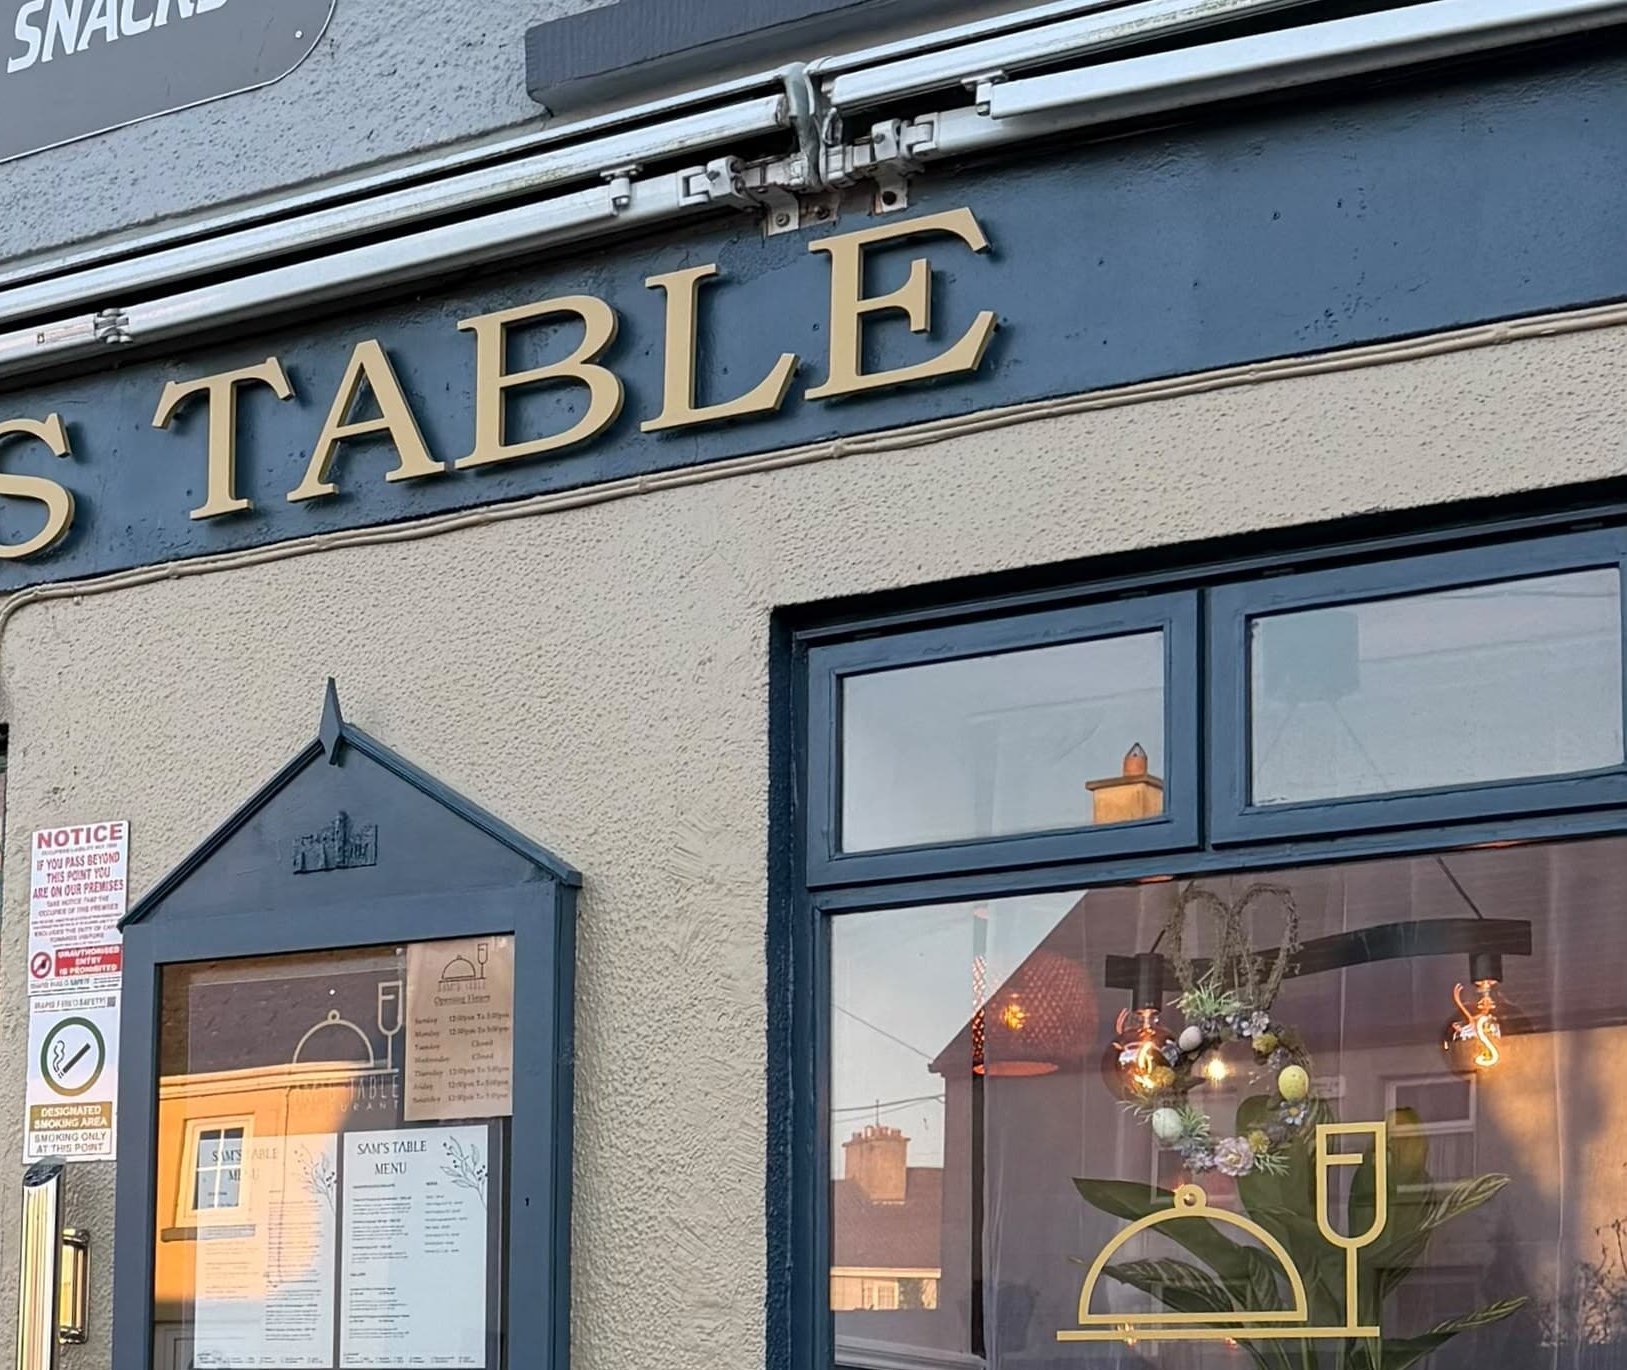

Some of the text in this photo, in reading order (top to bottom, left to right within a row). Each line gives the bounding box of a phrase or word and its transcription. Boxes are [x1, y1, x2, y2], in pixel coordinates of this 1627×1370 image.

[152, 206, 999, 520] TABLE
[37, 823, 123, 849] NOTICE
[37, 851, 120, 871] IF YOU PASS BEYOND
[47, 866, 111, 883] THIS POINT YOU
[33, 879, 124, 899] ARE ON OUR PREMISES
[57, 946, 120, 959] UNAUTHORISED
[75, 956, 102, 966] ENTRY
[59, 964, 118, 976] IS PROHIBITED
[350, 1075, 400, 1100] TABLE
[41, 1105, 101, 1118] DESIGNATED
[34, 1117, 108, 1129] SMOKING AREA
[34, 1131, 107, 1143] SMOKING ONLY
[36, 1142, 104, 1154] AT THIS POINT
[356, 1139, 428, 1155] SAM'S TABLE
[374, 1161, 407, 1175] MENU
